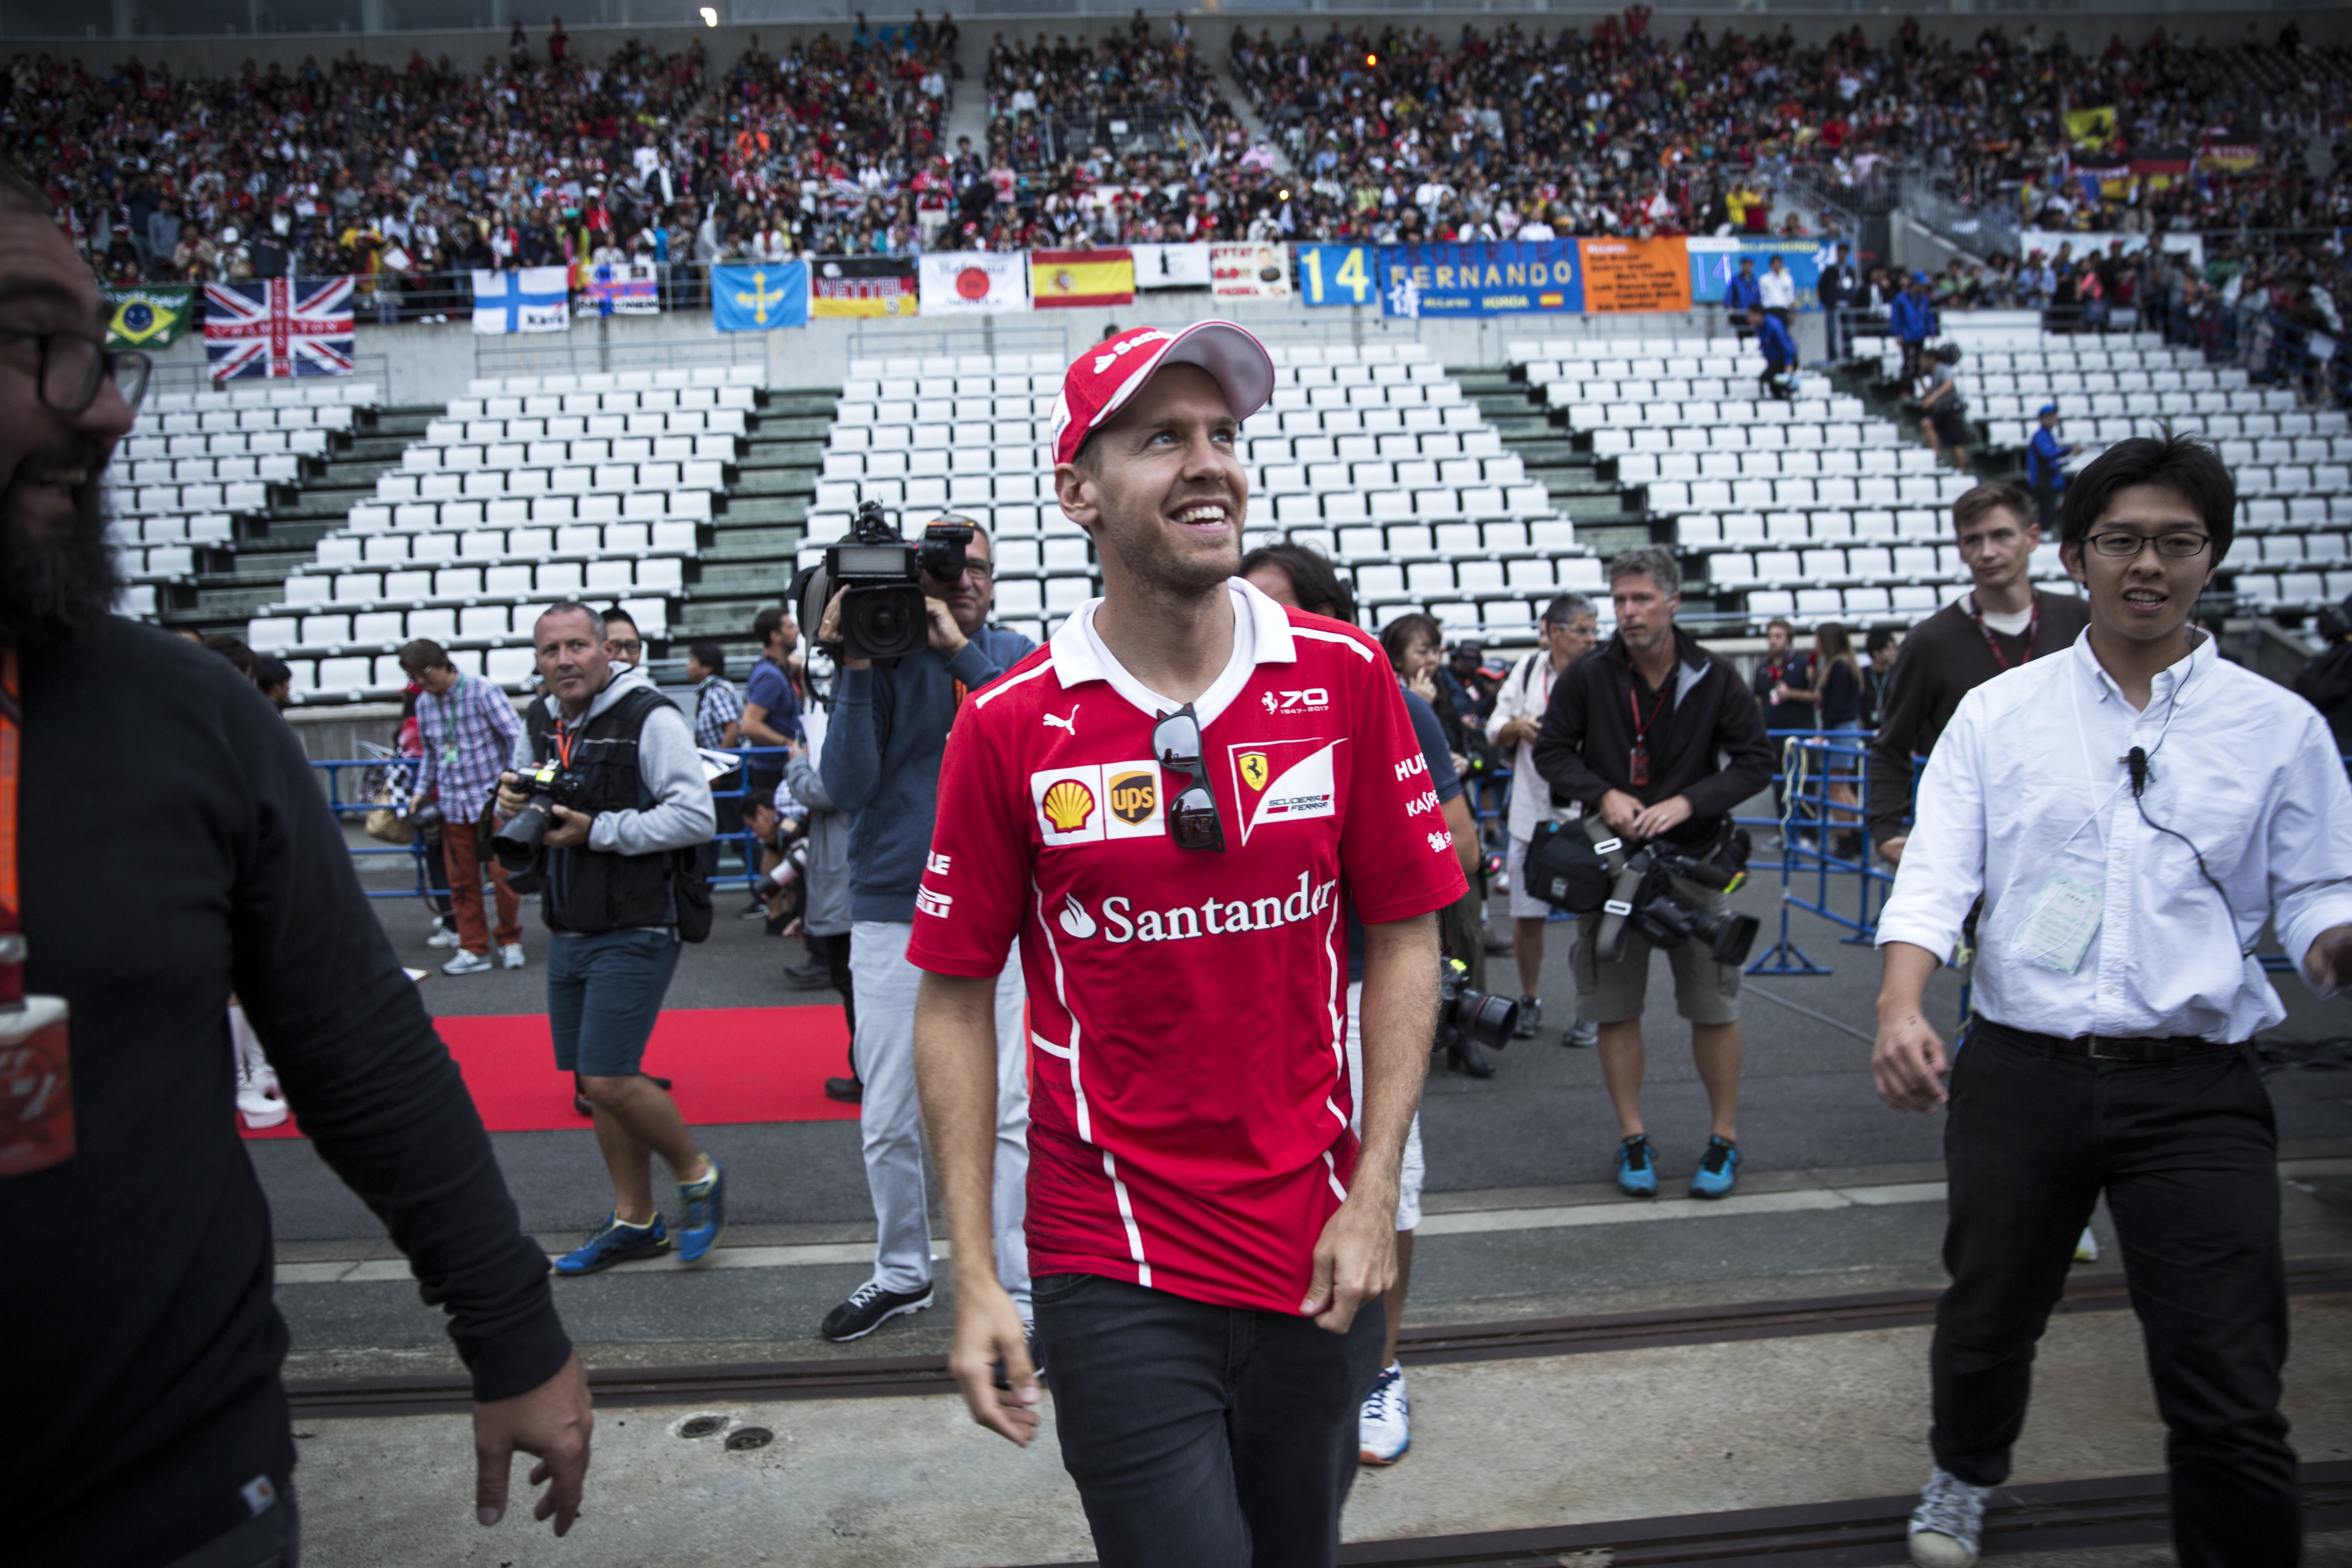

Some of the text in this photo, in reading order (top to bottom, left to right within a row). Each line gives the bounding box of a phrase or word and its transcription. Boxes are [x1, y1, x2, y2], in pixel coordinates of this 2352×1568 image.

[1301, 247, 1370, 303] 14
[1390, 260, 1572, 289] FERNANDO
[1696, 252, 1733, 294] 14
[815, 276, 910, 301] VETTEL
[885, 296, 900, 316] 5
[1482, 295, 1530, 310] HONDA
[1279, 688, 1329, 708] 70
[1279, 706, 1329, 714] 1947-2017
[1112, 786, 1154, 818] ups
[1268, 795, 1321, 807] SCUDERIA
[1290, 802, 1328, 812] FERRARI
[1102, 870, 1336, 943] Santander
